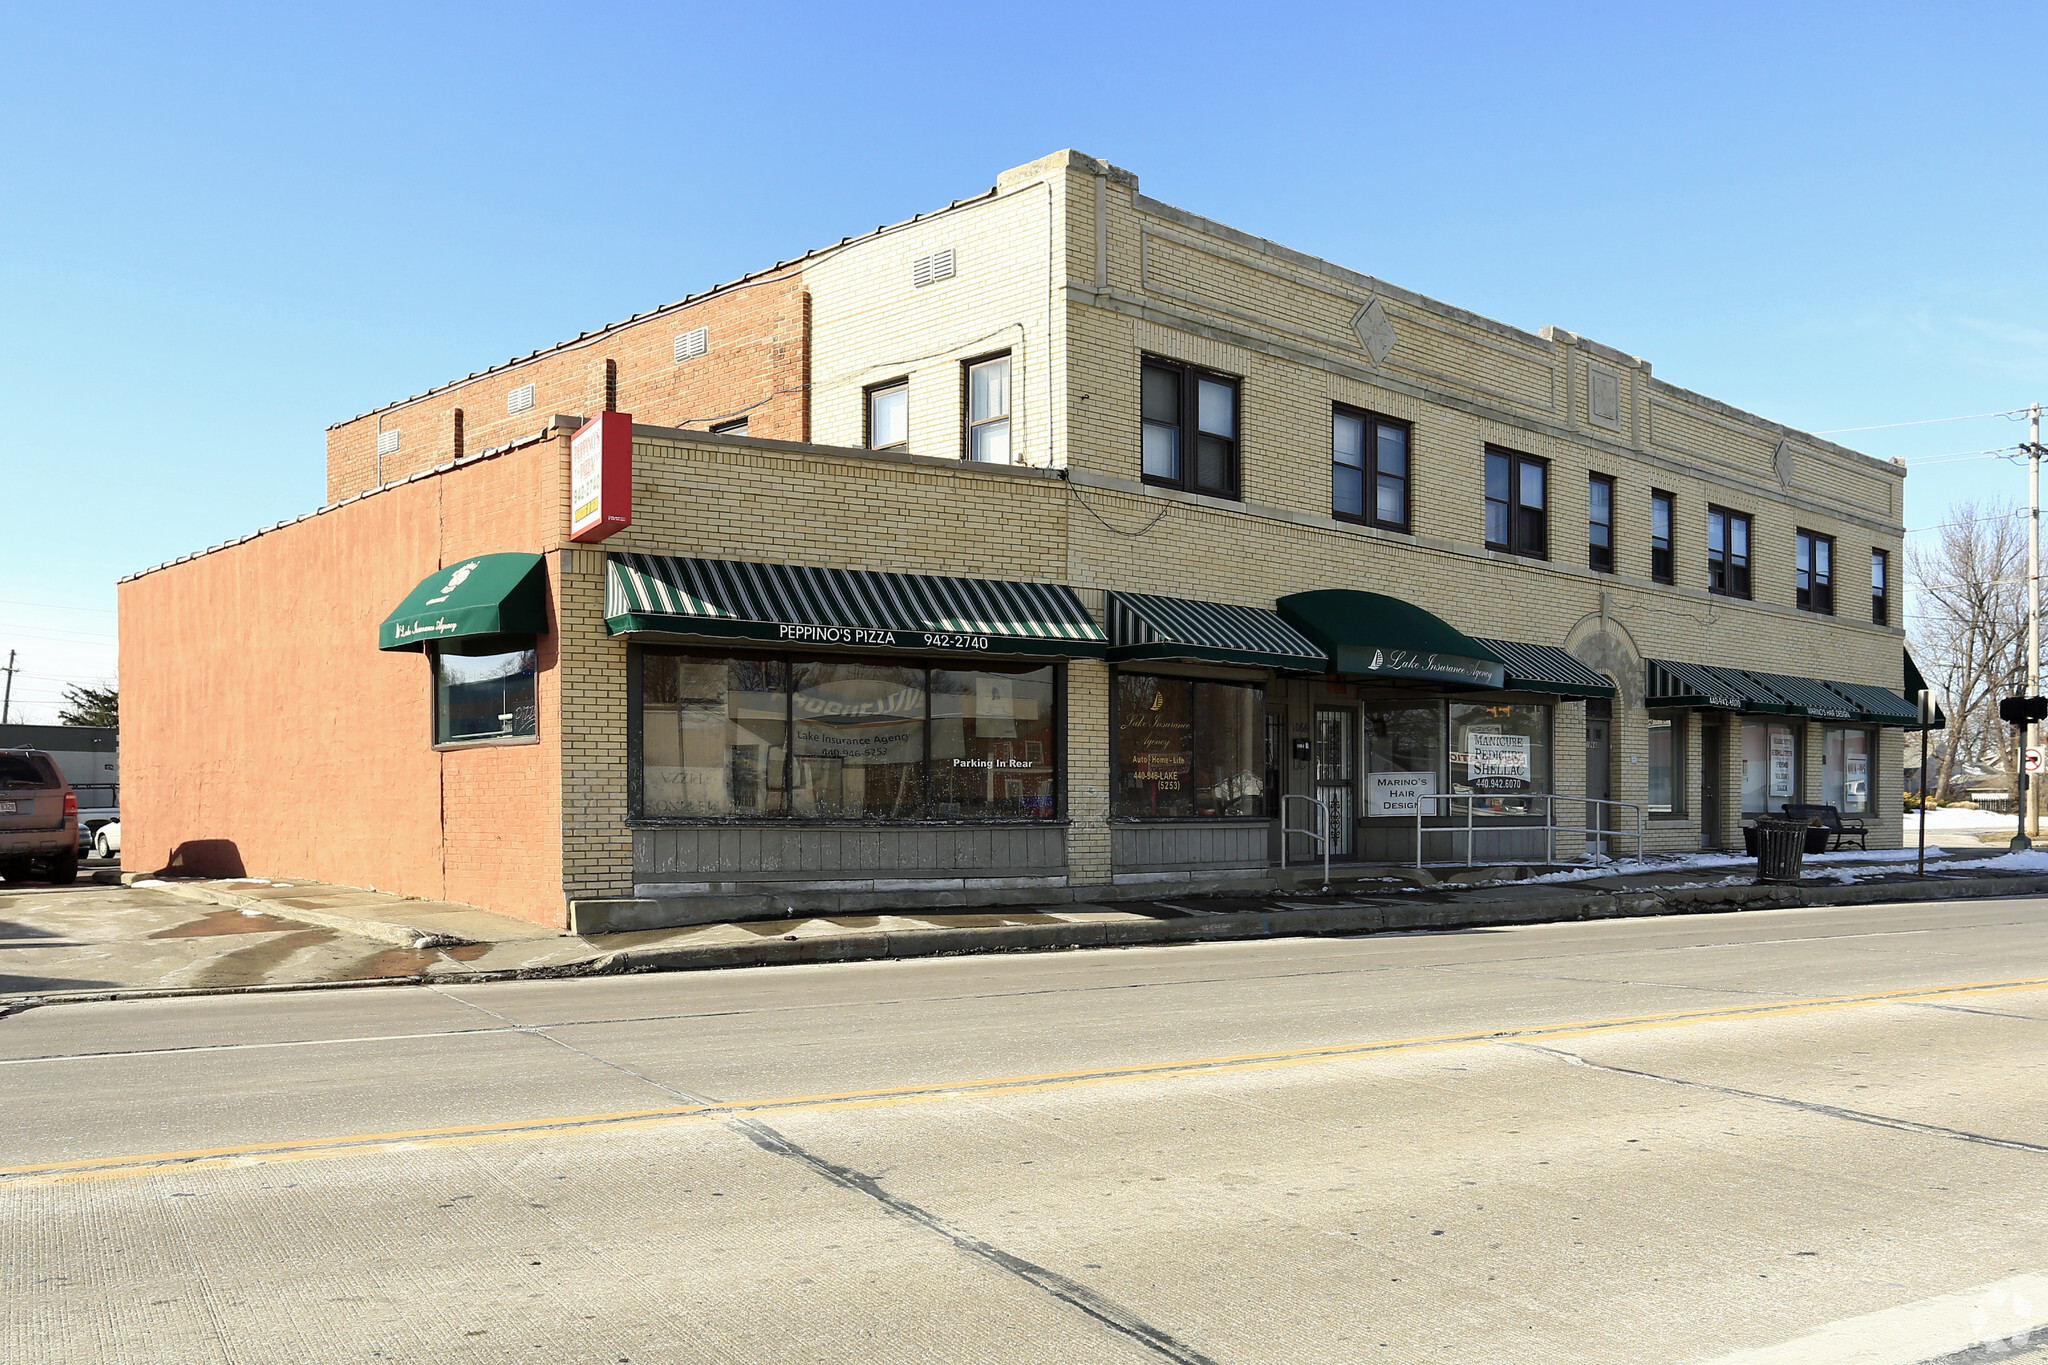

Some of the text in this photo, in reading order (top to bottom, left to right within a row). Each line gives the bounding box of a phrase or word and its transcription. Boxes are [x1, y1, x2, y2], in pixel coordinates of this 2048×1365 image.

[580, 457, 595, 478] PIZZA
[779, 624, 988, 650] PEPPINO'S PIZZA 942-2740
[1387, 650, 1493, 683] Lake Insurance Agency
[1120, 714, 1191, 730] Lake Insurance
[797, 731, 911, 745] Lake Insurance Agency
[1136, 731, 1171, 750] Agency
[1473, 734, 1524, 748] MANICURE
[1132, 755, 1147, 763] Auto
[1151, 756, 1169, 764] Home
[1173, 756, 1185, 764] Life
[1474, 747, 1524, 761] PEDICURE
[953, 758, 1033, 770] Parking In Rear
[1473, 761, 1525, 776] SHELLAC
[1133, 771, 1178, 780] 440-946-LAKE
[1377, 778, 1428, 787] MARINO'S
[1157, 780, 1181, 791] (5253)
[1389, 790, 1415, 798] HAIR
